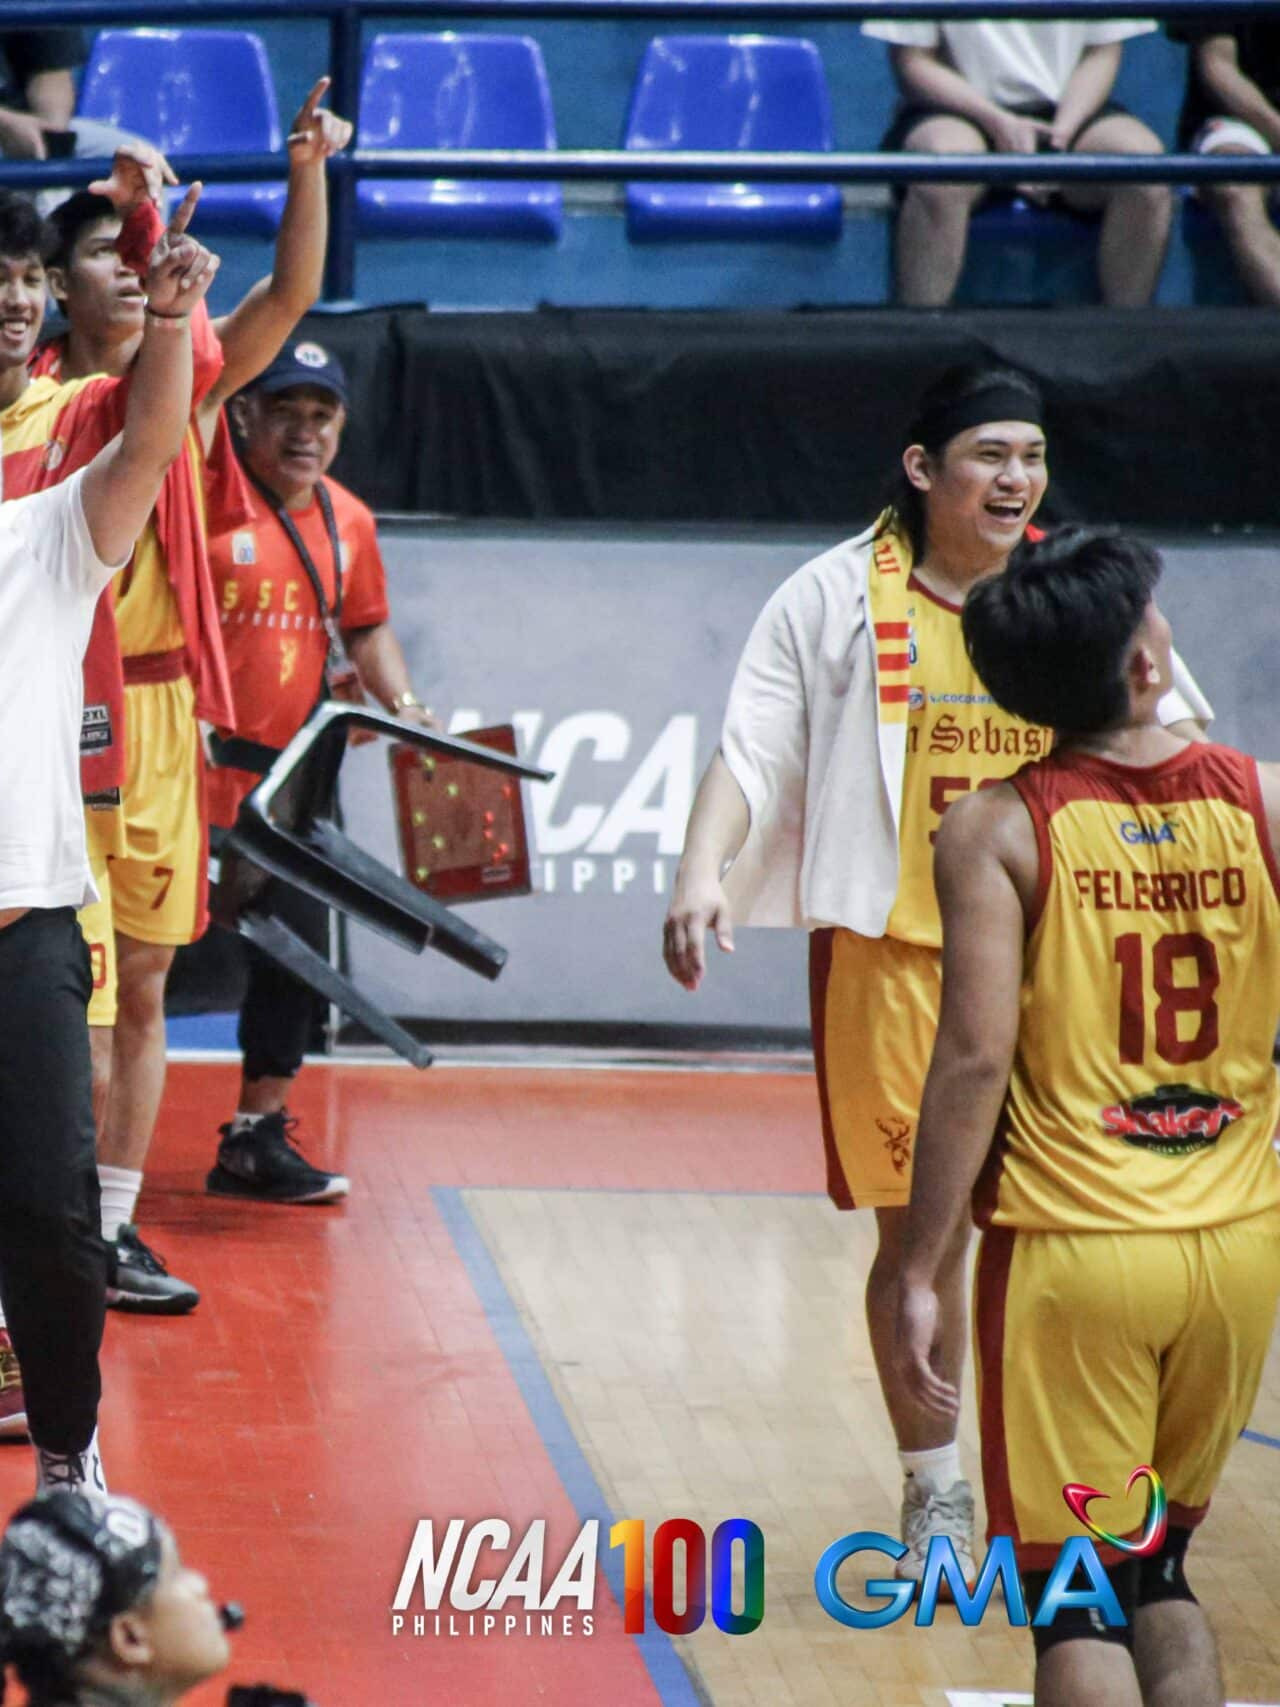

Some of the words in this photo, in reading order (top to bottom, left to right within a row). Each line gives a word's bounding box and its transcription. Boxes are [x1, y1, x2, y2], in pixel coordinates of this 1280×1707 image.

[943, 693, 996, 705] COCOLIF
[150, 866, 175, 911] 7
[1114, 932, 1221, 1066] 18
